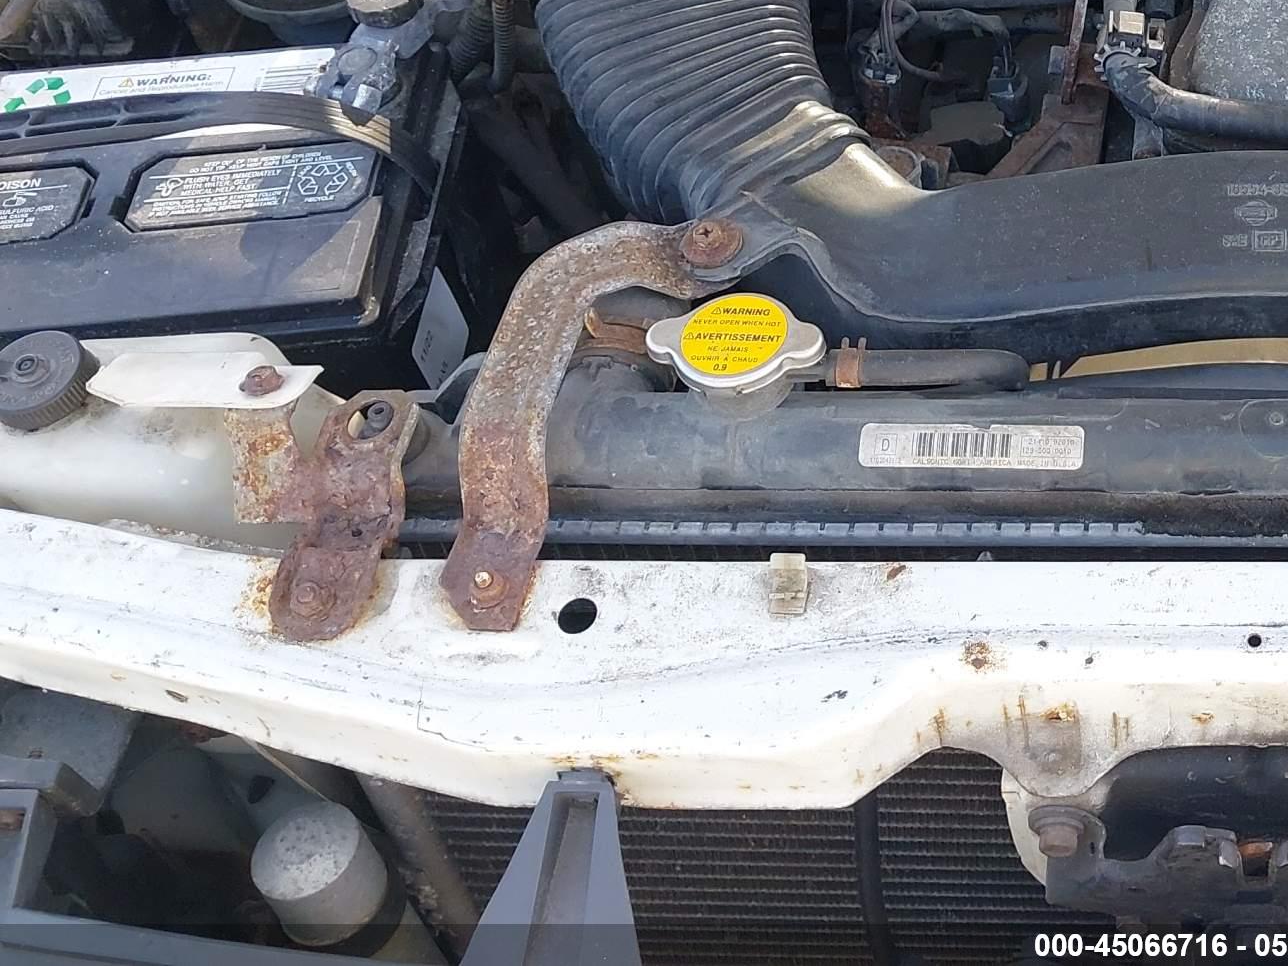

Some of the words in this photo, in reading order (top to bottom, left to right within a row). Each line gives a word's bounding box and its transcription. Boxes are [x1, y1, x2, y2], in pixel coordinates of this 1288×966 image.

[136, 73, 212, 87] WARNING:
[211, 174, 231, 182] EYES
[232, 169, 282, 179] IMMEDIATELY
[233, 177, 249, 185] GET
[180, 188, 214, 196] MEDICAL
[215, 185, 236, 193] HELP
[304, 194, 336, 203] RECYCLE
[36, 204, 55, 212] ACID
[722, 307, 771, 316] WARNING
[695, 332, 781, 343] AVERTISSEMENT
[690, 354, 720, 362] OUVRIR
[712, 363, 728, 371] 0.9
[881, 438, 890, 452] D
